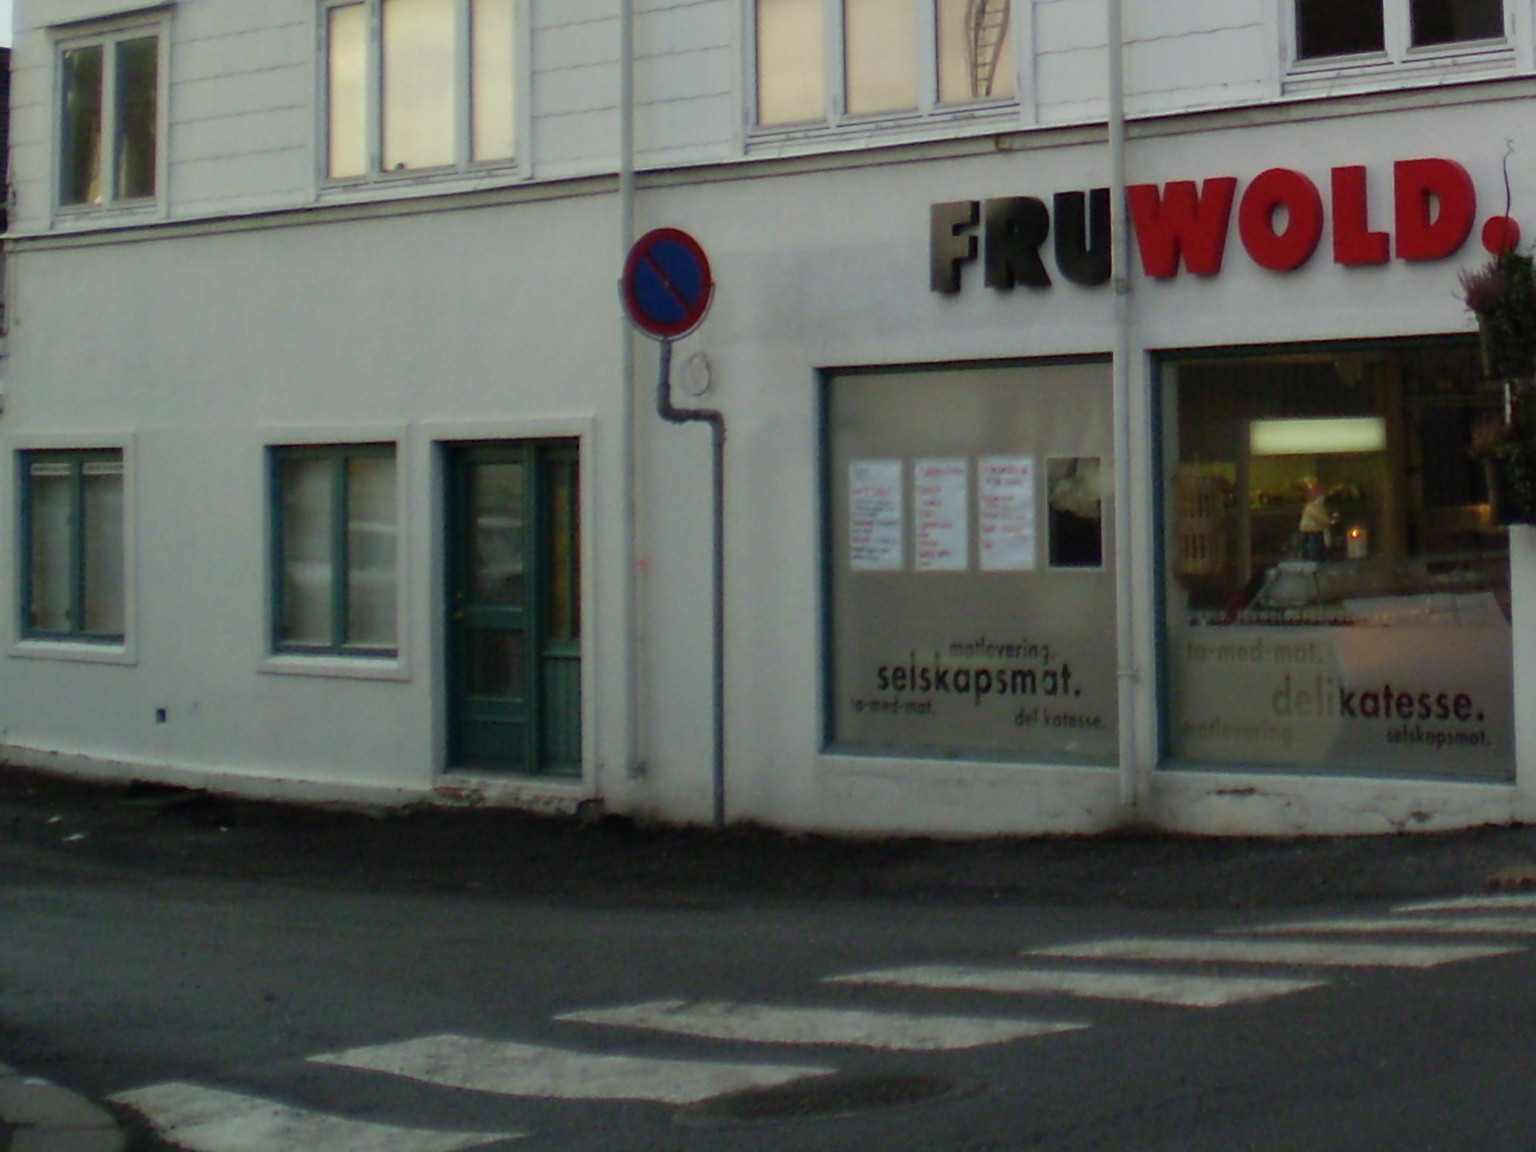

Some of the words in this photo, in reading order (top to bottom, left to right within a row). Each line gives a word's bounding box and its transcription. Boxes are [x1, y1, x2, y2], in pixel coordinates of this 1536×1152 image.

[930, 187, 1112, 293] FRU
[877, 649, 1082, 706] selskapsmat.
[1271, 672, 1486, 720] delikatesse.
